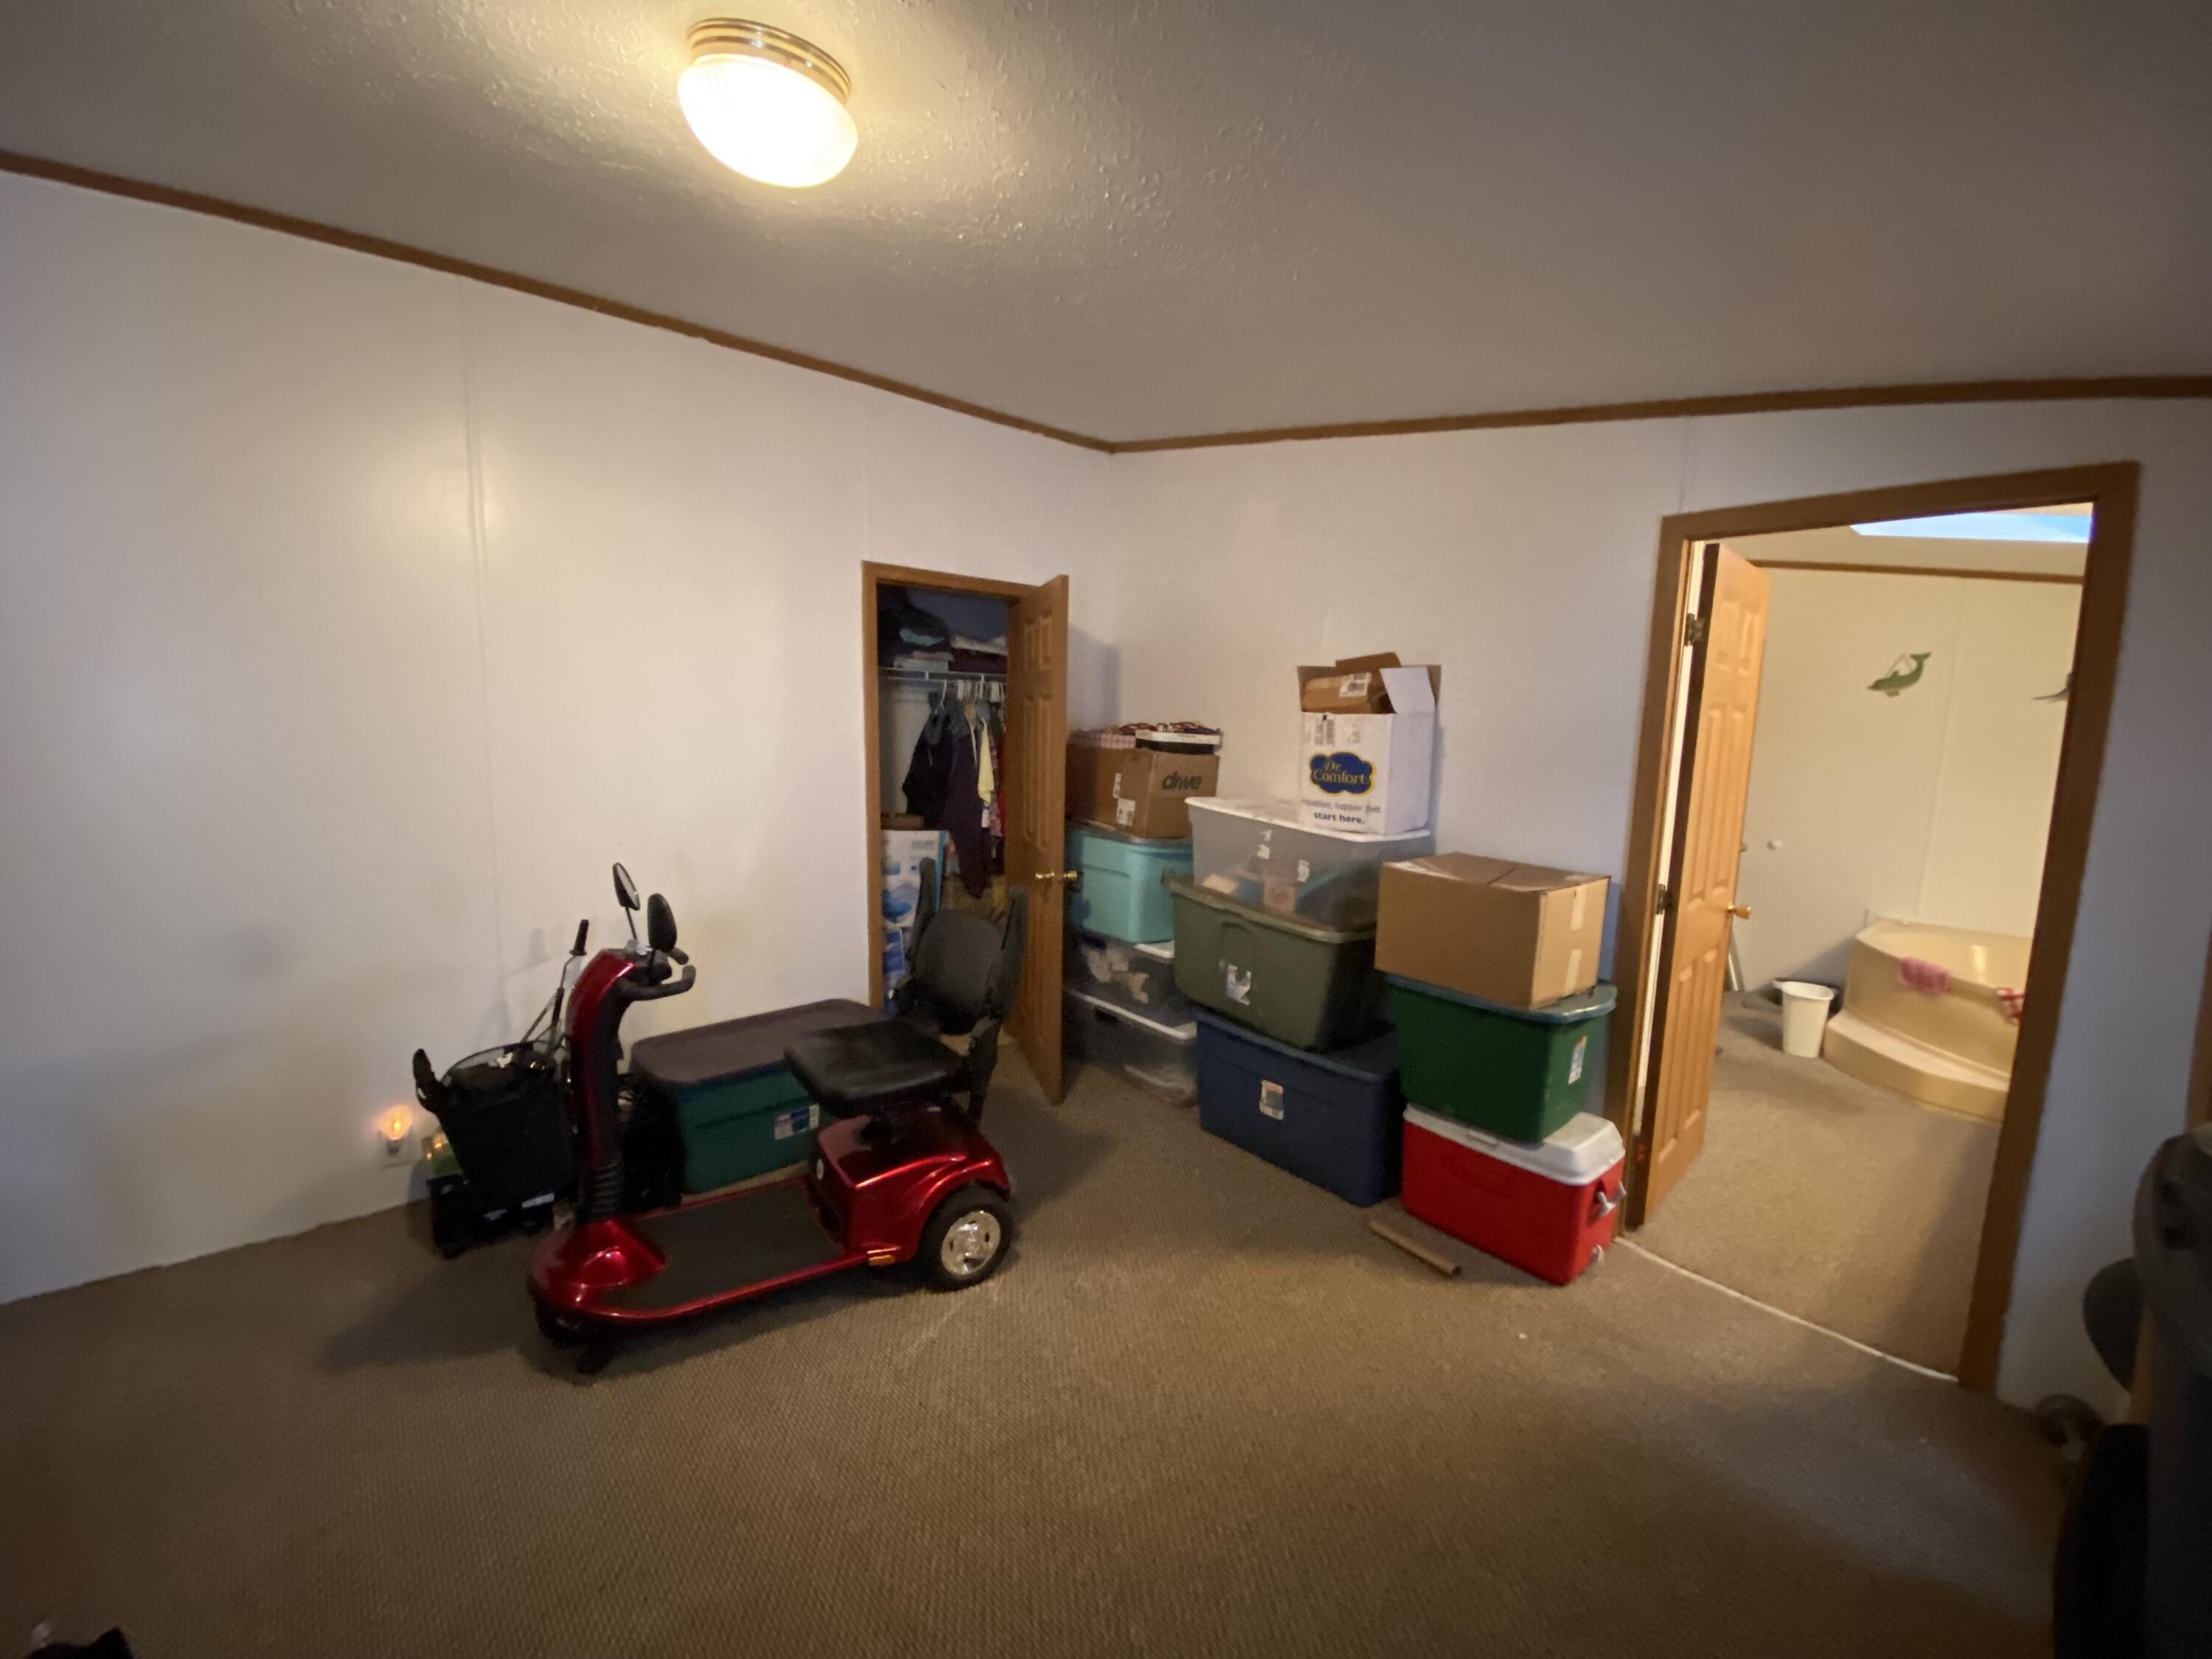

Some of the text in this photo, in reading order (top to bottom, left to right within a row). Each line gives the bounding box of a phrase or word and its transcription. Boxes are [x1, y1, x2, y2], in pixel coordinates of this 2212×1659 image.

[1324, 759, 1341, 772] Dr.
[1161, 771, 1203, 790] drive
[1313, 769, 1366, 785] Comfort
[1314, 812, 1366, 824] start here.
